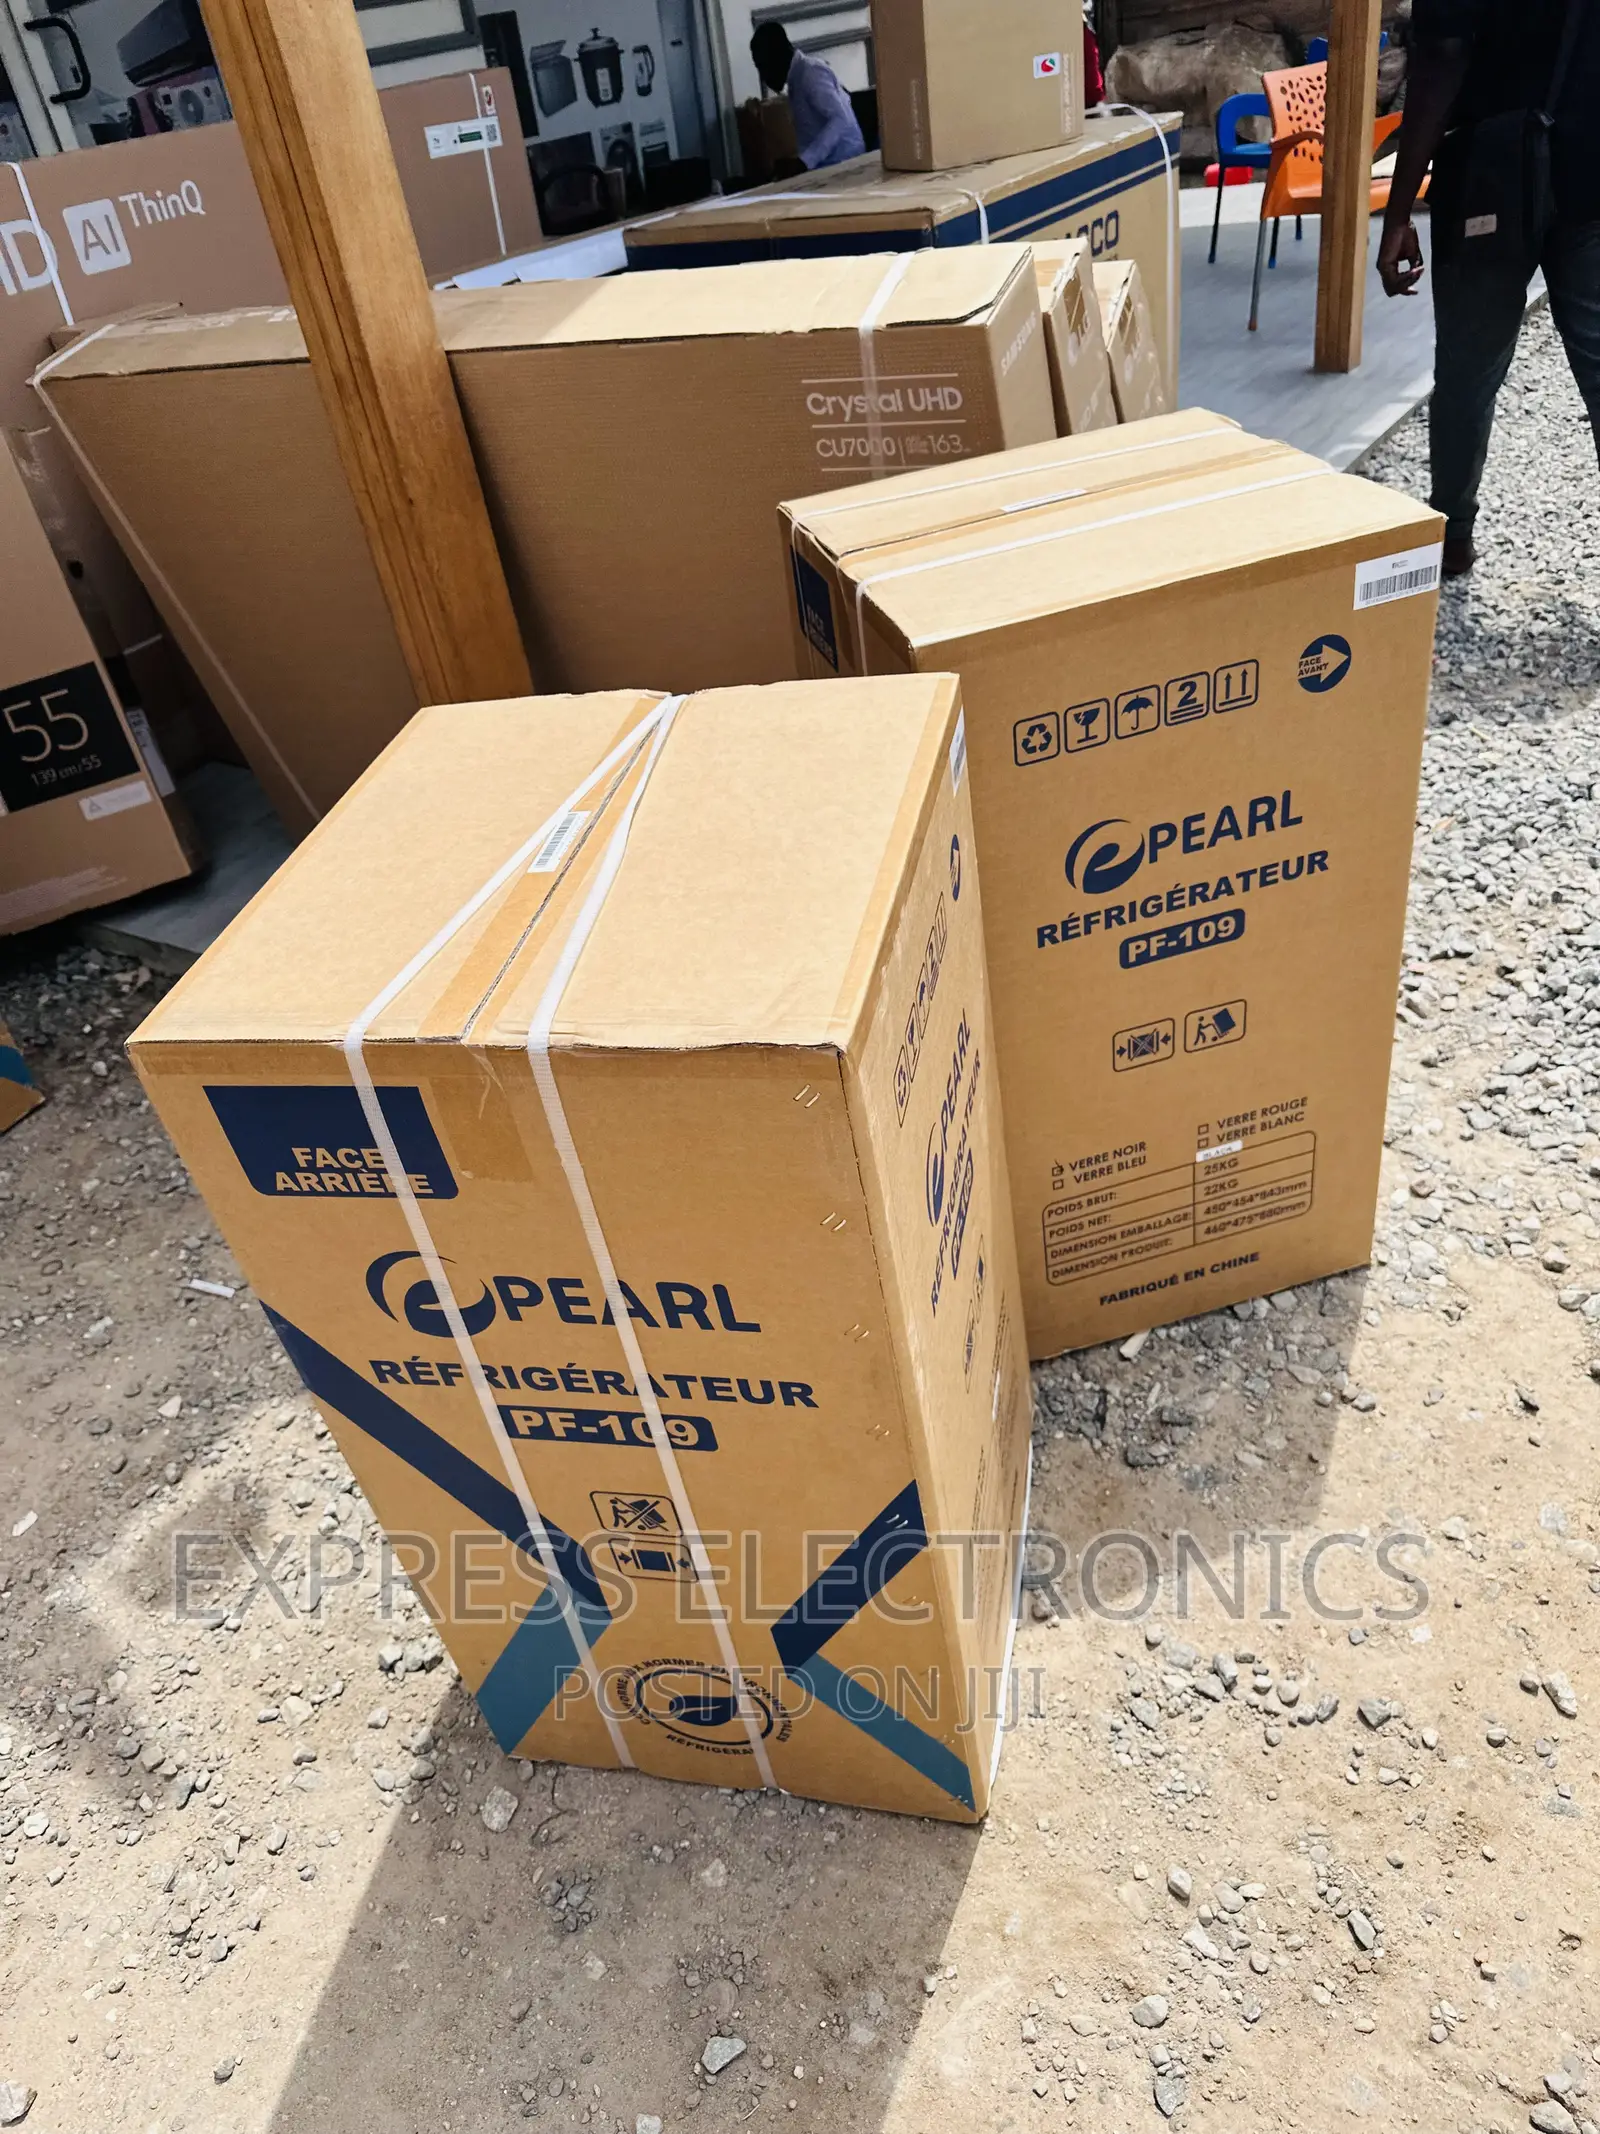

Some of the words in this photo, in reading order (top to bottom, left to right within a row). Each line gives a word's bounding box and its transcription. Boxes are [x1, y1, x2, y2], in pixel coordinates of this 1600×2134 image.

[82, 214, 121, 261] AI
[118, 180, 206, 227] ThinQ
[806, 388, 903, 422] Crystal
[907, 386, 964, 412] UHD
[816, 436, 896, 457] CU7000
[1297, 662, 1329, 677] AVANT
[1298, 656, 1321, 669] FACE
[1177, 681, 1197, 708] 2
[3, 688, 89, 762] 55
[1148, 790, 1303, 864] PEARL
[1036, 850, 1329, 949] RÉFRIGÉRATEUR
[1128, 915, 1236, 964] PF-109
[941, 1008, 971, 1153] PEARL
[1216, 1124, 1257, 1143] VERRE
[1260, 1111, 1305, 1132] BLANC
[1217, 1110, 1257, 1129] VERRE
[1261, 1096, 1308, 1118] ROUGE
[292, 1147, 388, 1169] FACE
[1069, 1152, 1109, 1172] VERRE
[1113, 1141, 1147, 1160] NOIR
[1074, 1165, 1113, 1184] VERRE
[1117, 1155, 1147, 1174] BLEU
[1203, 1157, 1239, 1176] 25KG
[275, 1168, 434, 1194] ARRIÈE
[1203, 1178, 1239, 1197] 22KG
[1047, 1202, 1083, 1218] POIDS
[1049, 1222, 1084, 1239] POIDS
[1051, 1233, 1117, 1259] DIMENSION
[1052, 1253, 1118, 1279] DIMENSION
[1100, 1273, 1180, 1306] FABRIQUÉ
[1184, 1267, 1205, 1283] EN
[1210, 1252, 1260, 1274] CHINE
[492, 1276, 762, 1333] PEARL
